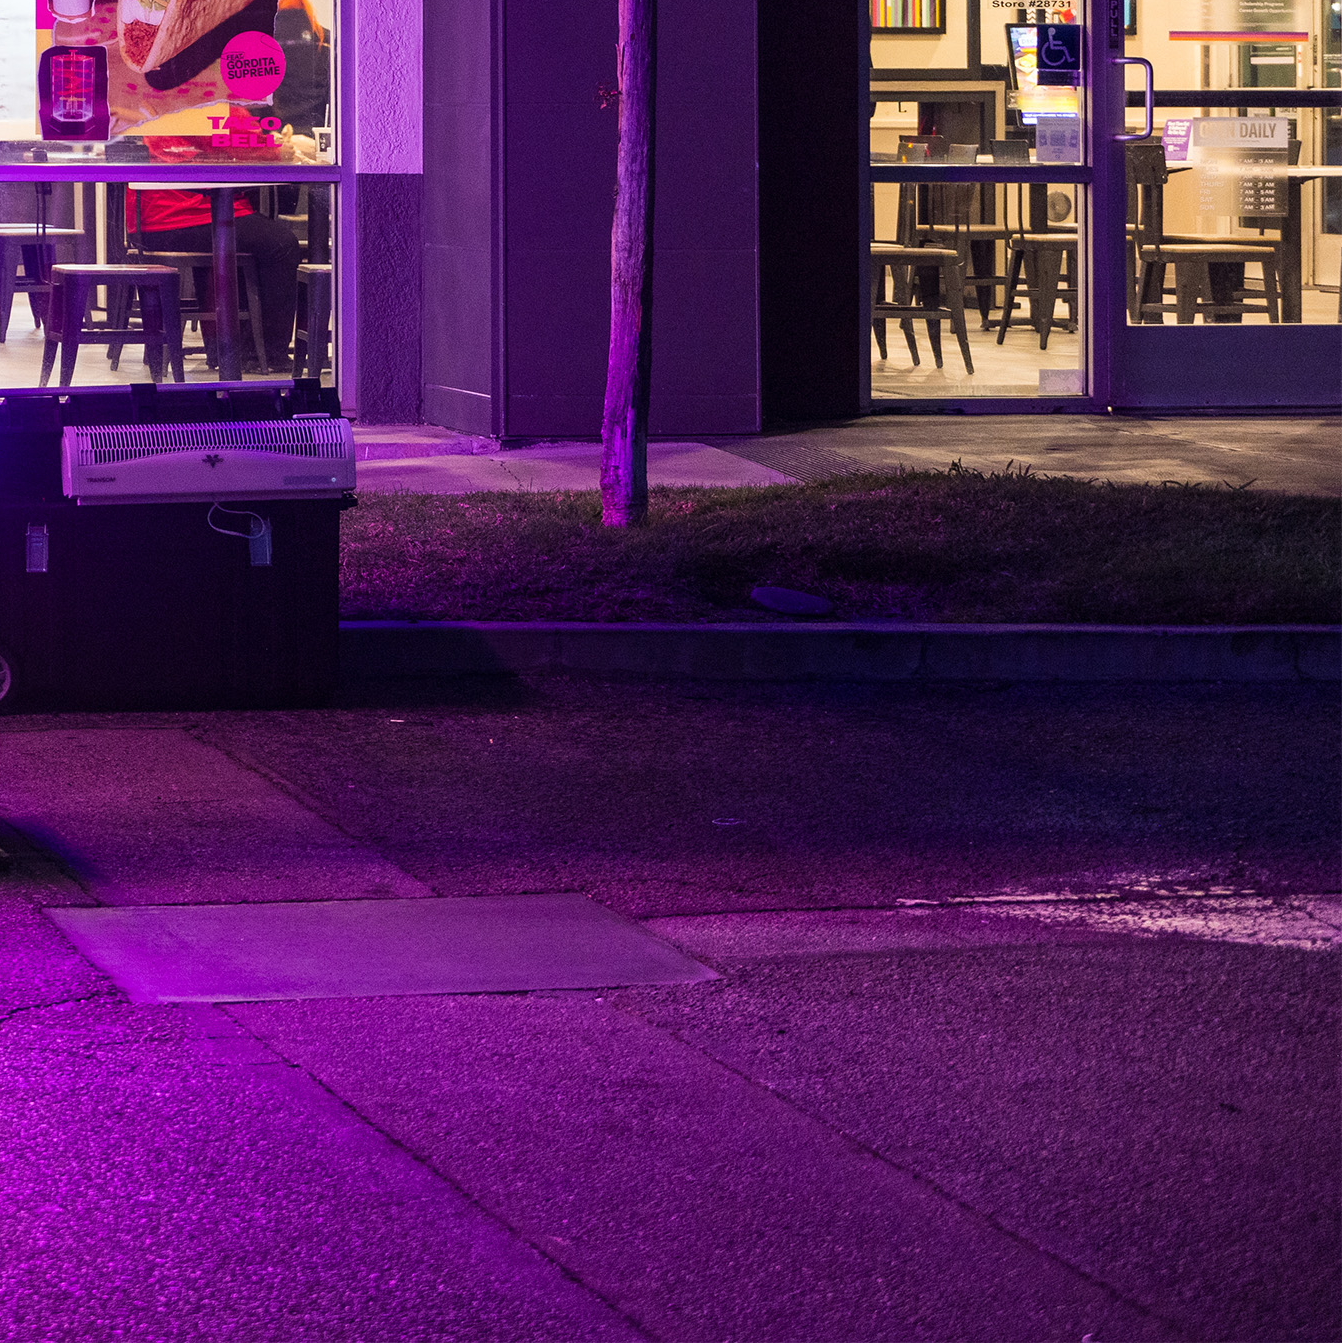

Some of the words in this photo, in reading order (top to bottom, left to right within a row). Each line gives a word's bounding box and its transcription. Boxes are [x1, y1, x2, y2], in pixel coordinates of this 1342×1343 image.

[992, 0, 1025, 8] Store
[1029, 0, 1072, 8] #28731
[226, 57, 275, 70] GORDITA
[227, 66, 280, 79] SUPREME
[207, 117, 282, 131] TACO
[1240, 122, 1276, 139] DAILY
[211, 134, 283, 148] BELL
